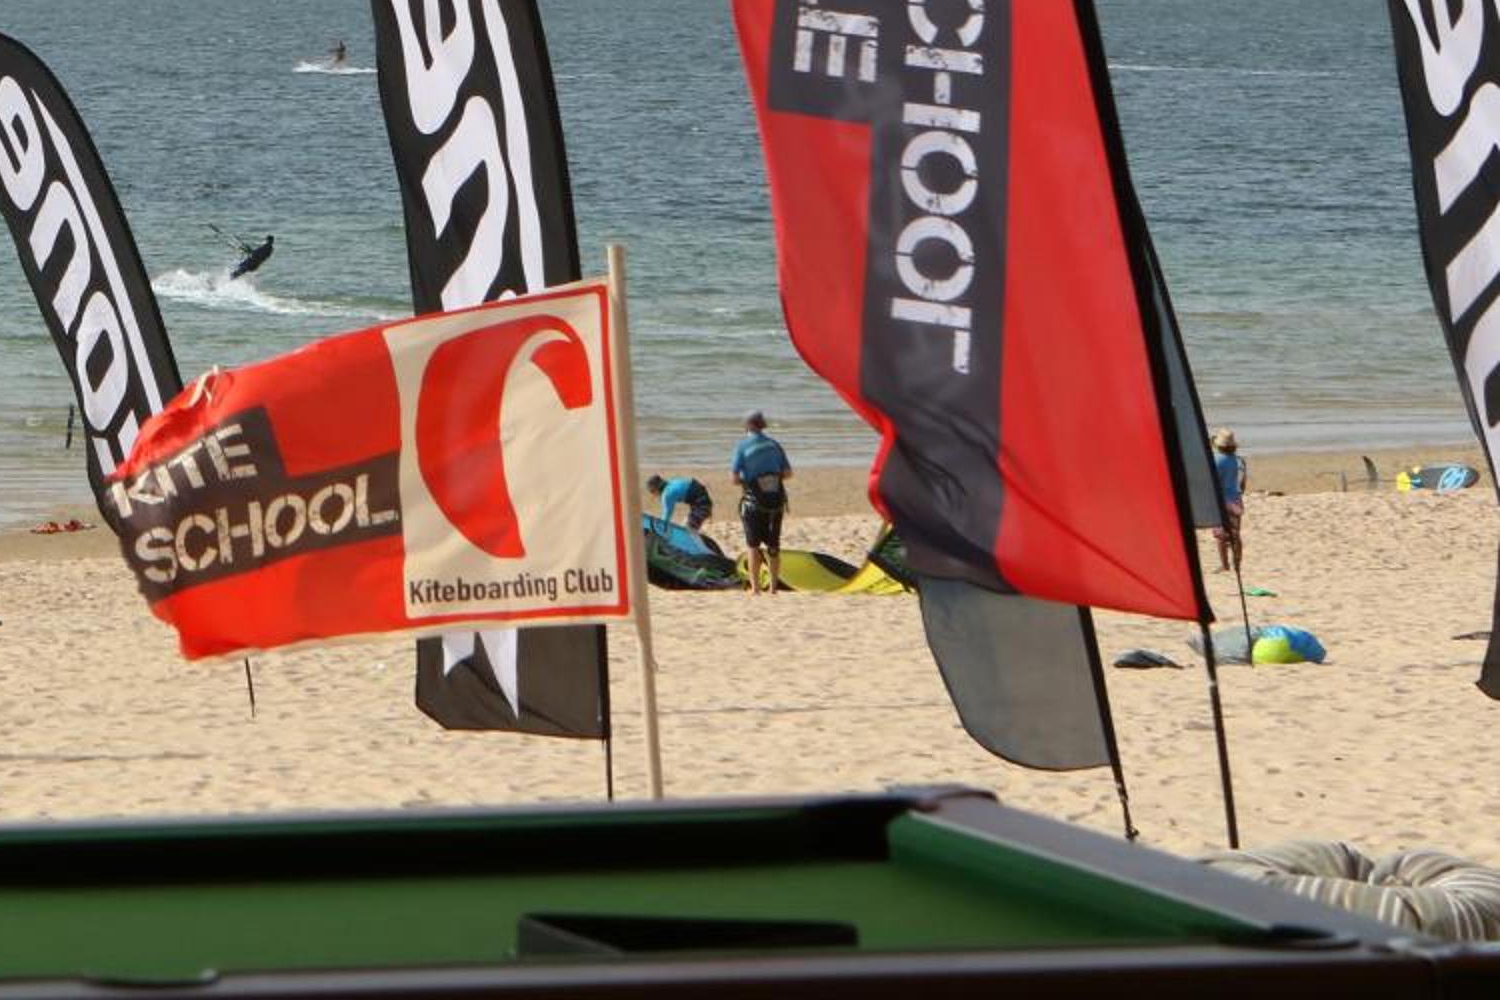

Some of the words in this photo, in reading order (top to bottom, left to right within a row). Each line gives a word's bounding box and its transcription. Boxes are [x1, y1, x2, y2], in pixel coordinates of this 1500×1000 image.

[111, 423, 258, 518] KITE
[135, 473, 399, 583] SCHOOL
[409, 573, 558, 604] Kiteboarding
[564, 567, 614, 594] Club
